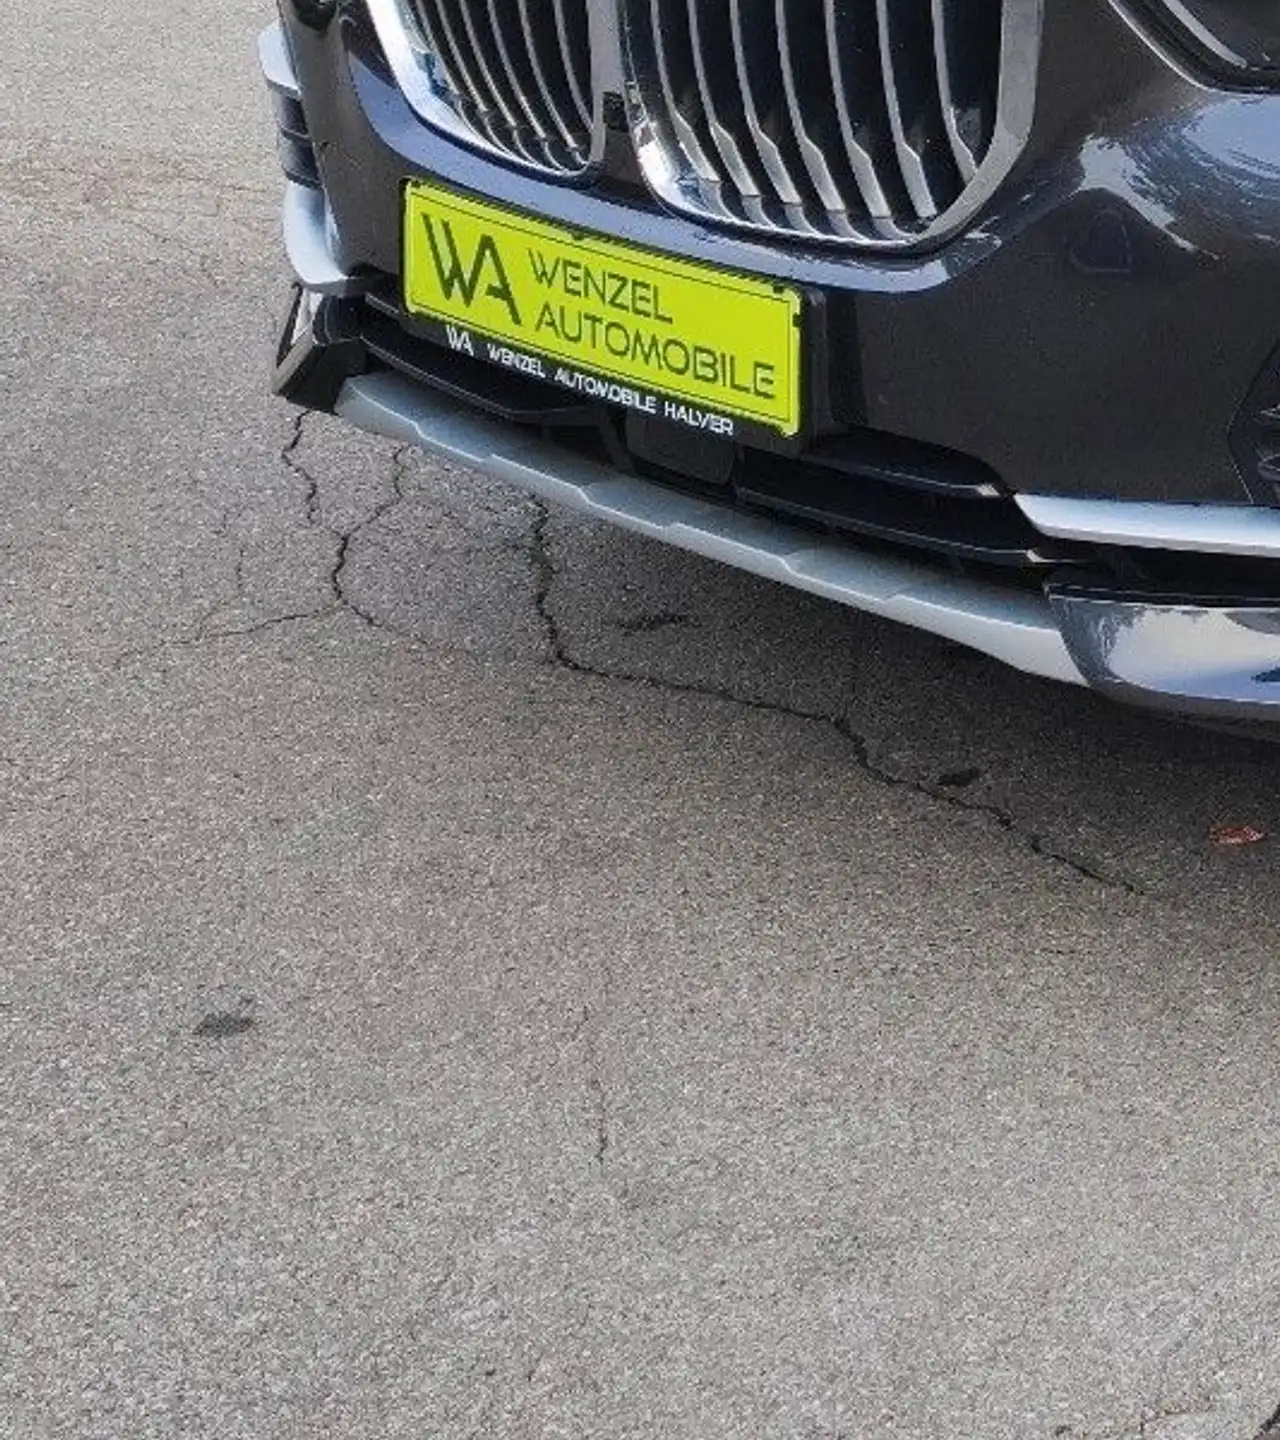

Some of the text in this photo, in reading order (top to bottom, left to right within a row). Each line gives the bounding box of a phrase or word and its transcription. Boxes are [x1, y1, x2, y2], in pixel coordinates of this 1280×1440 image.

[420, 211, 521, 326] WA
[528, 248, 673, 325] WENZEL
[445, 324, 735, 437] WA WENZEL AUTOMOBILE HALVER
[535, 300, 775, 400] AUTOMOBILE
